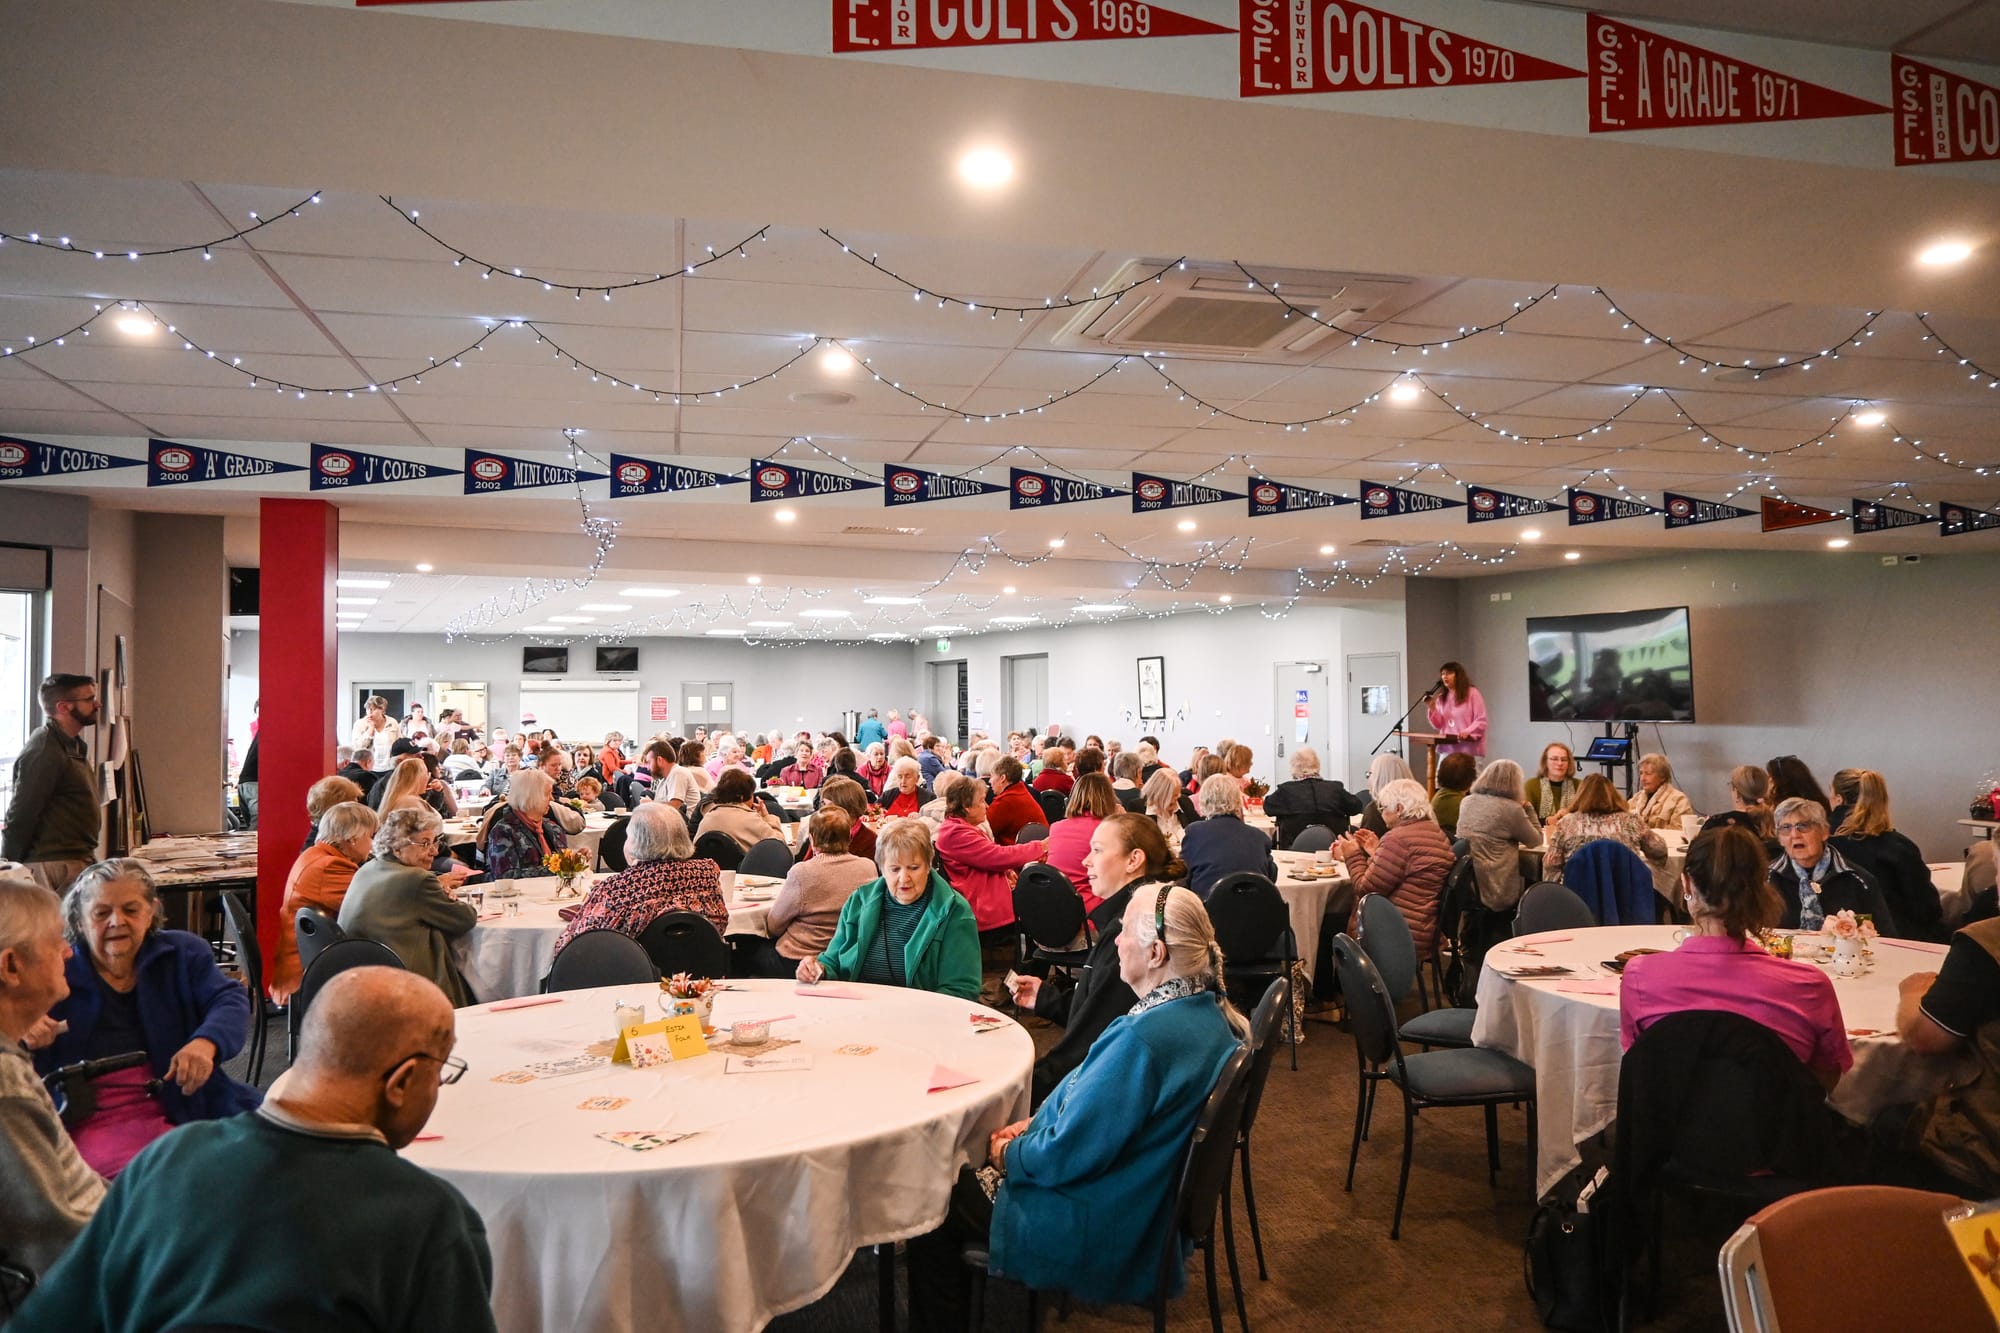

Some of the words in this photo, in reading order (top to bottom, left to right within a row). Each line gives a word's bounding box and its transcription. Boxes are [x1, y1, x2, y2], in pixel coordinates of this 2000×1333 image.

[1089, 0, 1150, 36] 1969
[1252, 0, 1281, 90] .S.F.L.
[1295, 0, 1308, 83] JUNIOR
[1323, 3, 1453, 85] COLTS
[1461, 46, 1515, 80] 1970
[1663, 47, 1741, 119] GRADE
[1751, 71, 1800, 117] 1971
[1934, 81, 1947, 154] JUNIOR
[60, 449, 109, 472] COLTS
[203, 451, 218, 479] 'A'
[224, 455, 274, 477] GRADE
[382, 459, 427, 481] COLTS
[160, 472, 189, 481] 2000
[321, 477, 349, 485] 2002
[513, 461, 541, 487] MINI
[543, 466, 577, 484] COLTS
[675, 468, 716, 488] COLTS
[813, 473, 852, 493] COLTS
[475, 481, 501, 489] 2002
[620, 485, 645, 493] 2003
[927, 474, 951, 499] MINI
[952, 480, 982, 497] COLTS
[1067, 481, 1103, 501] COLTS
[1171, 482, 1194, 505] MINI
[1195, 487, 1222, 503] COLTS
[893, 494, 917, 502] 2004
[1141, 501, 1162, 509] 2007
[1410, 494, 1443, 511] COLTS
[1516, 498, 1548, 515] GRADE
[1615, 500, 1647, 518] GRADE
